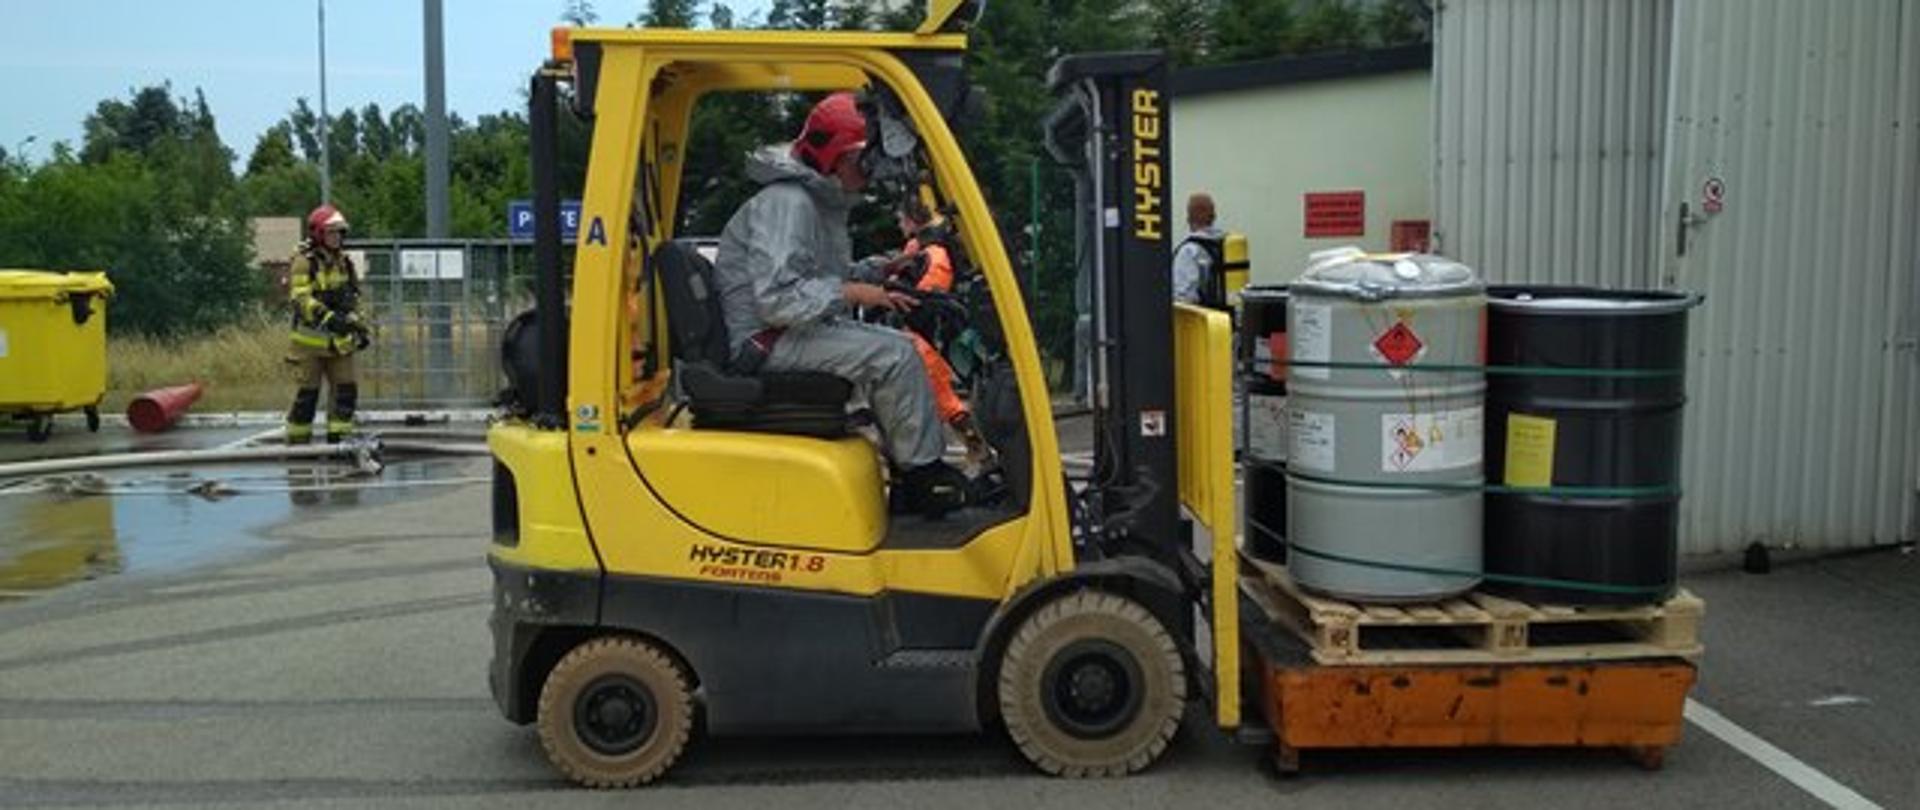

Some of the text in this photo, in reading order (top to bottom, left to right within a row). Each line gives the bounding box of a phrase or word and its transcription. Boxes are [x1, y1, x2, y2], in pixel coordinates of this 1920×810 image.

[1133, 89, 1161, 240] HYSTER
[586, 215, 608, 246] A
[689, 543, 826, 573] HYSTER 1.8
